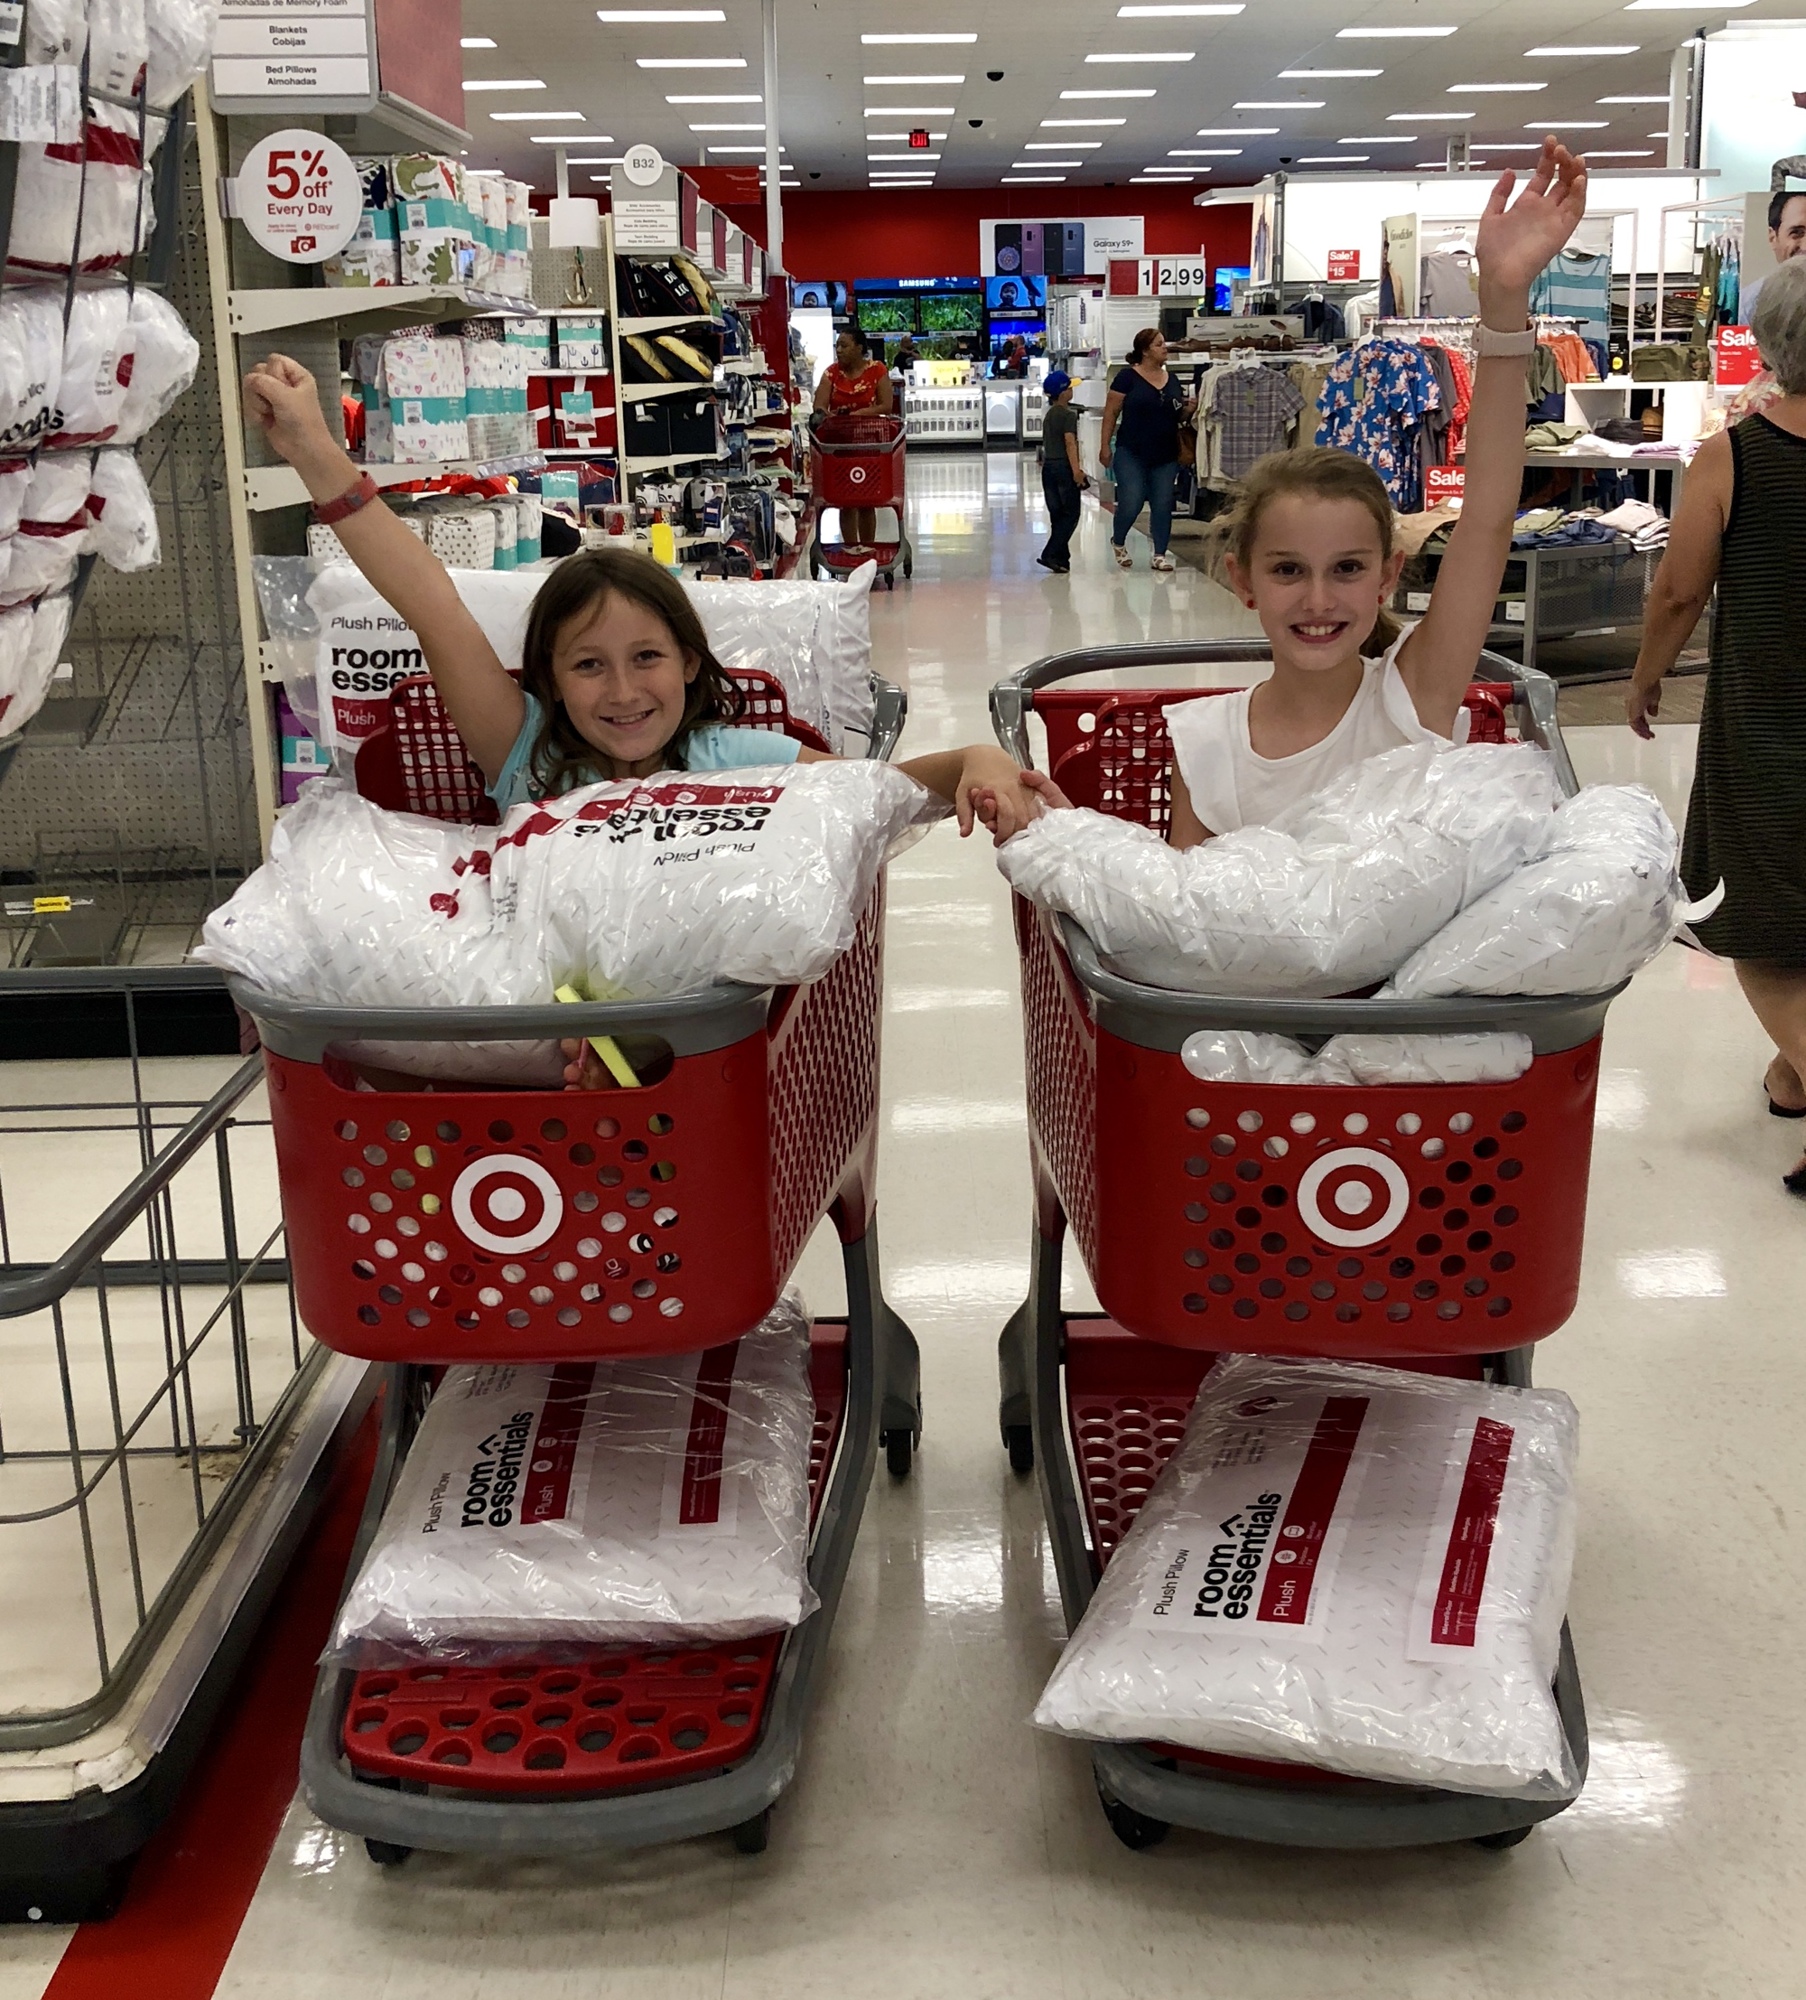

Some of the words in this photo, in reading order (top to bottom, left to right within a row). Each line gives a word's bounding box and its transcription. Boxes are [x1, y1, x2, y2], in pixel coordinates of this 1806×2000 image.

[269, 26, 308, 34] Blankets
[272, 38, 306, 47] Cobijas
[265, 66, 283, 74] Bed
[285, 66, 317, 74] Pillows
[267, 78, 317, 86] Almohadas
[911, 132, 928, 147] EXIT
[632, 158, 655, 169] B32
[267, 203, 304, 217] Every
[308, 202, 333, 216] Day
[1093, 240, 1121, 248] Galaxy
[1329, 251, 1354, 261] Sale!
[898, 280, 935, 288] SAMSUNG
[1429, 469, 1466, 486] Sale
[331, 617, 373, 631] Plush
[376, 617, 411, 631] Pillo
[331, 648, 422, 669] room
[337, 709, 376, 726] Plush
[488, 1410, 535, 1528] essentials
[430, 1472, 451, 1501] Pillow
[461, 1460, 497, 1528] room
[534, 1484, 554, 1516] Plush
[422, 1501, 443, 1534] Plush
[1165, 1548, 1190, 1579] Pillow
[1222, 1492, 1282, 1620] essentials
[1193, 1543, 1238, 1618] room
[1153, 1580, 1178, 1616] Plush
[1273, 1580, 1296, 1617] Plush
